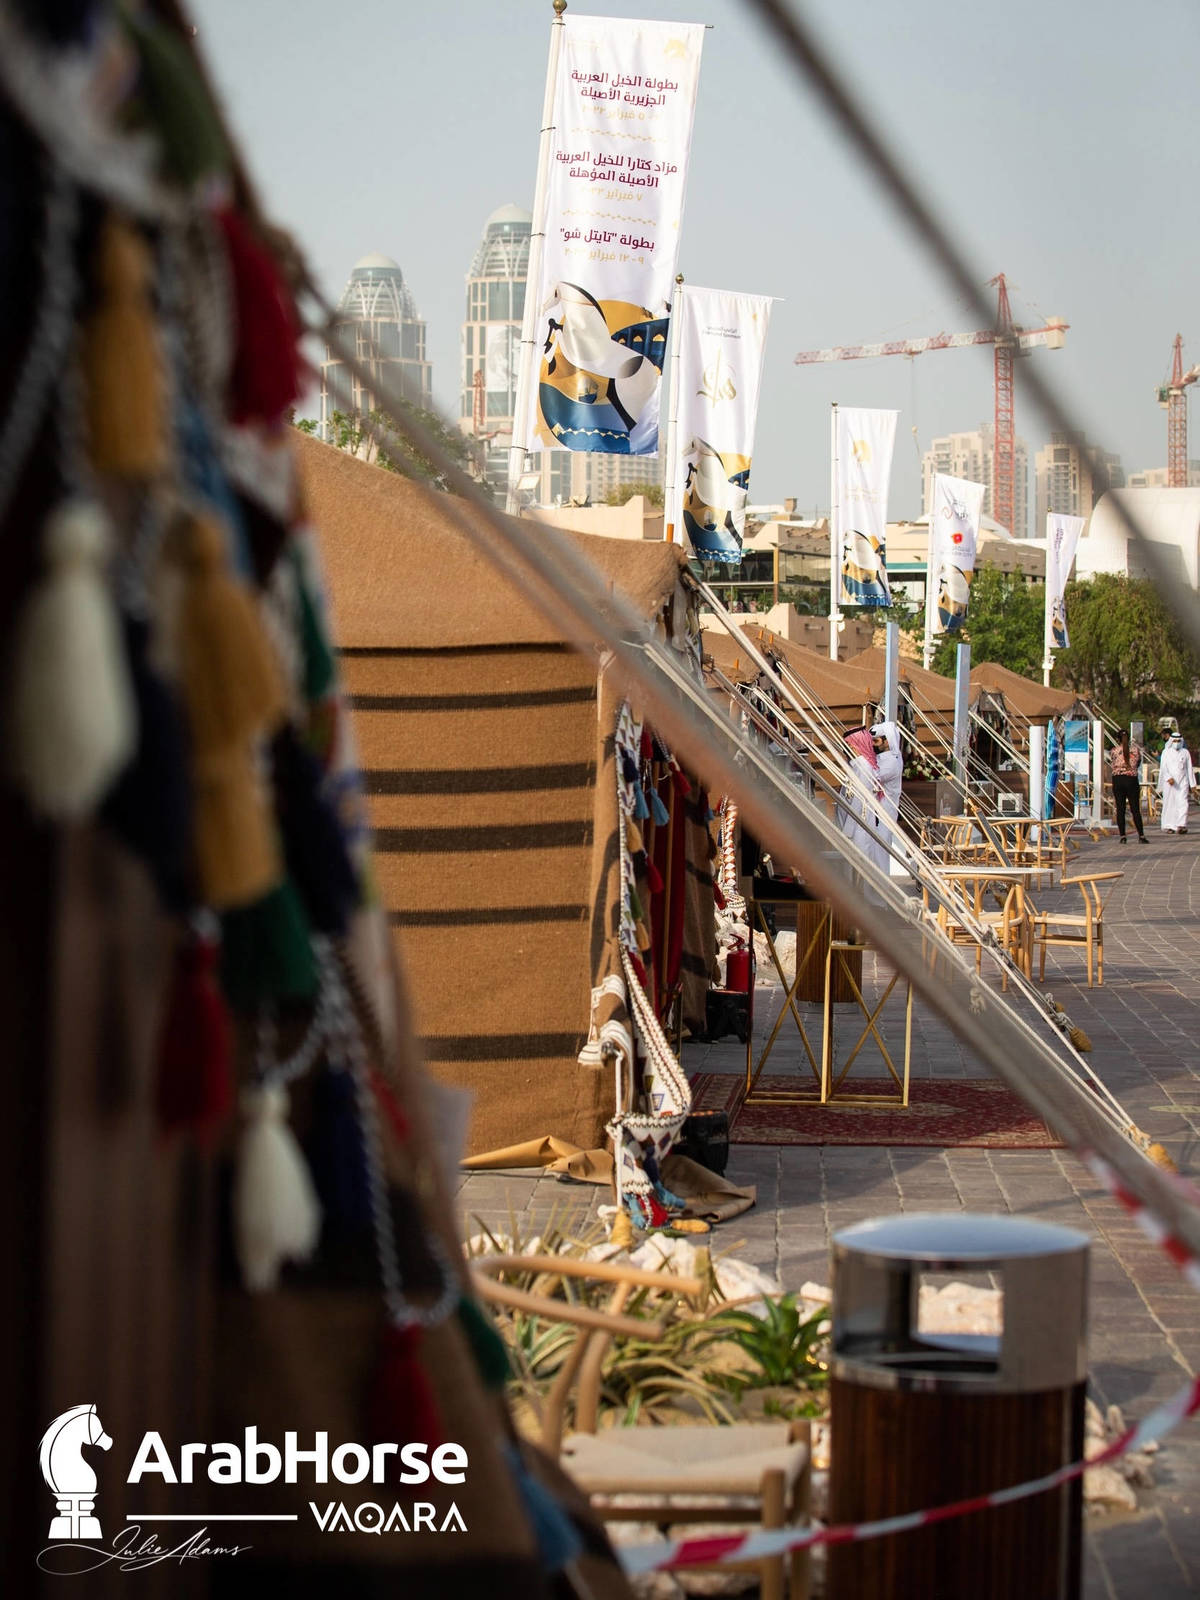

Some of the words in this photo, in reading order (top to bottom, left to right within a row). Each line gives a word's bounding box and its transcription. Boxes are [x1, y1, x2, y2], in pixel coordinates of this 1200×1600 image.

[571, 69, 609, 84] العربية
[611, 74, 642, 87] الخيل
[644, 77, 679, 92] بطولة
[580, 87, 621, 101] الأصيلة
[624, 92, 666, 107] الجزيرية
[556, 150, 590, 164] العربية
[593, 153, 624, 166] للخيل
[627, 157, 653, 171] كتارا
[569, 167, 615, 181] المؤهلة
[654, 162, 678, 176] مزاد
[618, 172, 659, 188] الأصيلة
[560, 228, 581, 242] شو"
[584, 229, 617, 244] "تايتل
[620, 235, 655, 252] بطولة
